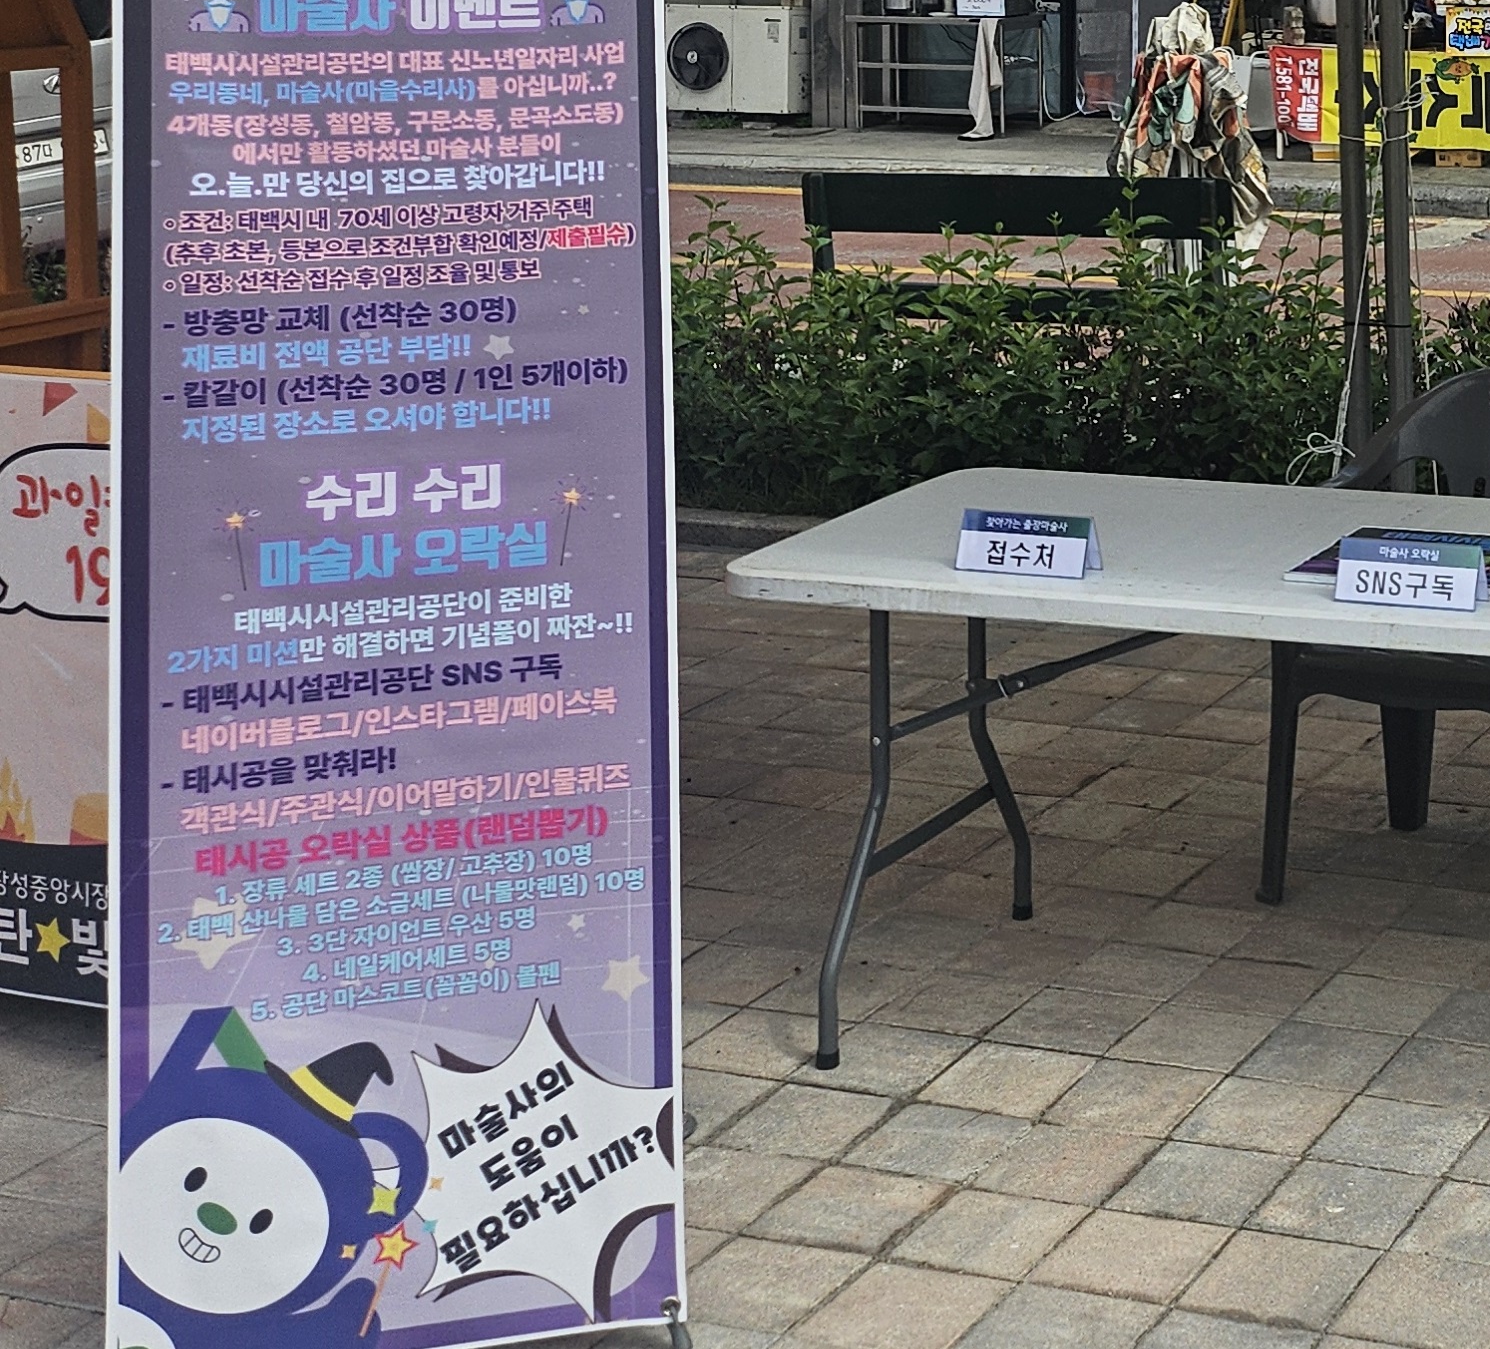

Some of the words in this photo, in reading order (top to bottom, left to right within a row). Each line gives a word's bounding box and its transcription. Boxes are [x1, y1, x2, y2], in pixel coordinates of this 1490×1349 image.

[166, 50, 393, 75] 태백시시설관리공단의
[399, 50, 443, 73] 대표
[451, 43, 578, 72] 신노년일자리
[584, 41, 624, 67] 사업
[169, 79, 270, 107] 우리동네,
[277, 73, 498, 103] 마술사(마을수리사)를
[504, 71, 617, 98] 아십니까..?
[168, 113, 319, 140] 4개동(장성동,
[326, 110, 401, 138] 철암동,
[408, 107, 502, 134] 구문소동,
[509, 102, 624, 129] 문곡소도동)
[232, 143, 302, 166] 에서만
[308, 137, 421, 163] 활동하셨던
[427, 136, 492, 159] 마술사
[496, 133, 561, 156] 분들이
[190, 171, 290, 199] 오.늘.만
[296, 170, 373, 196] 당신의
[381, 167, 457, 191] 집으로
[464, 161, 605, 189] 찾아갑니다!!
[181, 211, 231, 233] 조건:
[238, 209, 302, 232] 태백시
[308, 209, 329, 231] 내
[340, 206, 392, 229] 70세
[397, 204, 437, 227] 이상
[444, 202, 504, 225] 고령자
[508, 200, 548, 223] 거주
[553, 196, 593, 219] 주택
[165, 241, 221, 266] (추후
[226, 240, 275, 264] 초본,
[280, 237, 366, 262] 등본으로
[371, 235, 453, 259] 조건부합
[181, 273, 231, 296] 일정:
[237, 271, 302, 293] 선착순
[308, 268, 351, 291] 접수
[355, 267, 378, 288] 후
[383, 265, 422, 287] 일정
[427, 264, 469, 286] 조율
[473, 262, 496, 283] 및
[499, 260, 540, 282] 통보
[184, 307, 268, 339] 방충망
[275, 306, 330, 334] 교체
[340, 302, 431, 332] (선착순
[440, 297, 517, 326] 30명)
[182, 343, 266, 371] 재료비
[275, 341, 329, 369] 전액
[337, 338, 392, 365] 공단
[398, 335, 471, 363] 부담!!
[183, 377, 267, 408] 칼갈이
[278, 372, 371, 404] (선착순
[380, 367, 446, 397] 30명
[474, 364, 513, 391] 1인
[522, 356, 628, 387] 5개이하)
[182, 415, 266, 443] 지정된
[275, 410, 357, 439] 장소로
[364, 404, 445, 434] 오셔야
[453, 398, 550, 426] 합니다!!
[306, 471, 396, 520] 수리
[413, 464, 502, 514] 수리
[986, 517, 1021, 531] 찾아가는
[259, 538, 400, 588] 마술사
[414, 522, 548, 577] 오락실
[987, 540, 1055, 570] 접수처
[1379, 546, 1408, 560] 마술사
[1411, 547, 1439, 561] 오락실
[234, 590, 491, 634] 태백시시설관리공단이
[498, 582, 572, 612] 준비한
[1356, 569, 1454, 602] SNS구독
[167, 648, 238, 675] 2가지
[247, 638, 326, 666] 미션만
[332, 628, 434, 659] 해결하면
[442, 618, 540, 650] 기념품이
[546, 612, 633, 641] 짜잔~!!
[183, 666, 433, 712] 태백시시설관리공단
[442, 661, 502, 687] SNS
[510, 652, 562, 682] 구독
[181, 686, 618, 754] 네이버블로그/인스타그램/페이스북
[183, 757, 296, 794] 태시공을
[304, 748, 396, 783] 맞춰라!
[180, 762, 630, 834] 객관식/주관식/이어말하기/인물퀴즈
[195, 841, 291, 876] 태시공
[299, 826, 392, 863] 오락실
[400, 805, 608, 852] 상품(랜덤뽑기)
[216, 886, 236, 906] 1.
[243, 877, 286, 904] 장류
[294, 870, 338, 897] 세트
[346, 866, 383, 891] 2종
[460, 851, 535, 878] 고추장)
[542, 842, 593, 869] 10명
[158, 923, 181, 944] 2.
[187, 913, 234, 940] 태백
[240, 902, 307, 932] 산나물
[314, 896, 358, 923] 담은
[366, 884, 454, 916] 소금세트
[595, 866, 645, 892] 10명
[278, 937, 300, 956] 3.
[309, 929, 345, 953] 3단
[353, 917, 442, 947] 자이언트
[449, 910, 491, 935] 우산
[499, 905, 536, 929] 5명
[303, 965, 326, 984] 4.
[333, 943, 467, 981] 네일케어세트
[474, 937, 511, 962] 5명
[251, 1002, 274, 1021] 5.
[281, 991, 327, 1018] 공단
[515, 960, 561, 988] 볼펜
[438, 1060, 574, 1159] 마술사의
[480, 1114, 579, 1192] 도움이
[439, 1125, 657, 1274] 필요하십니까?
